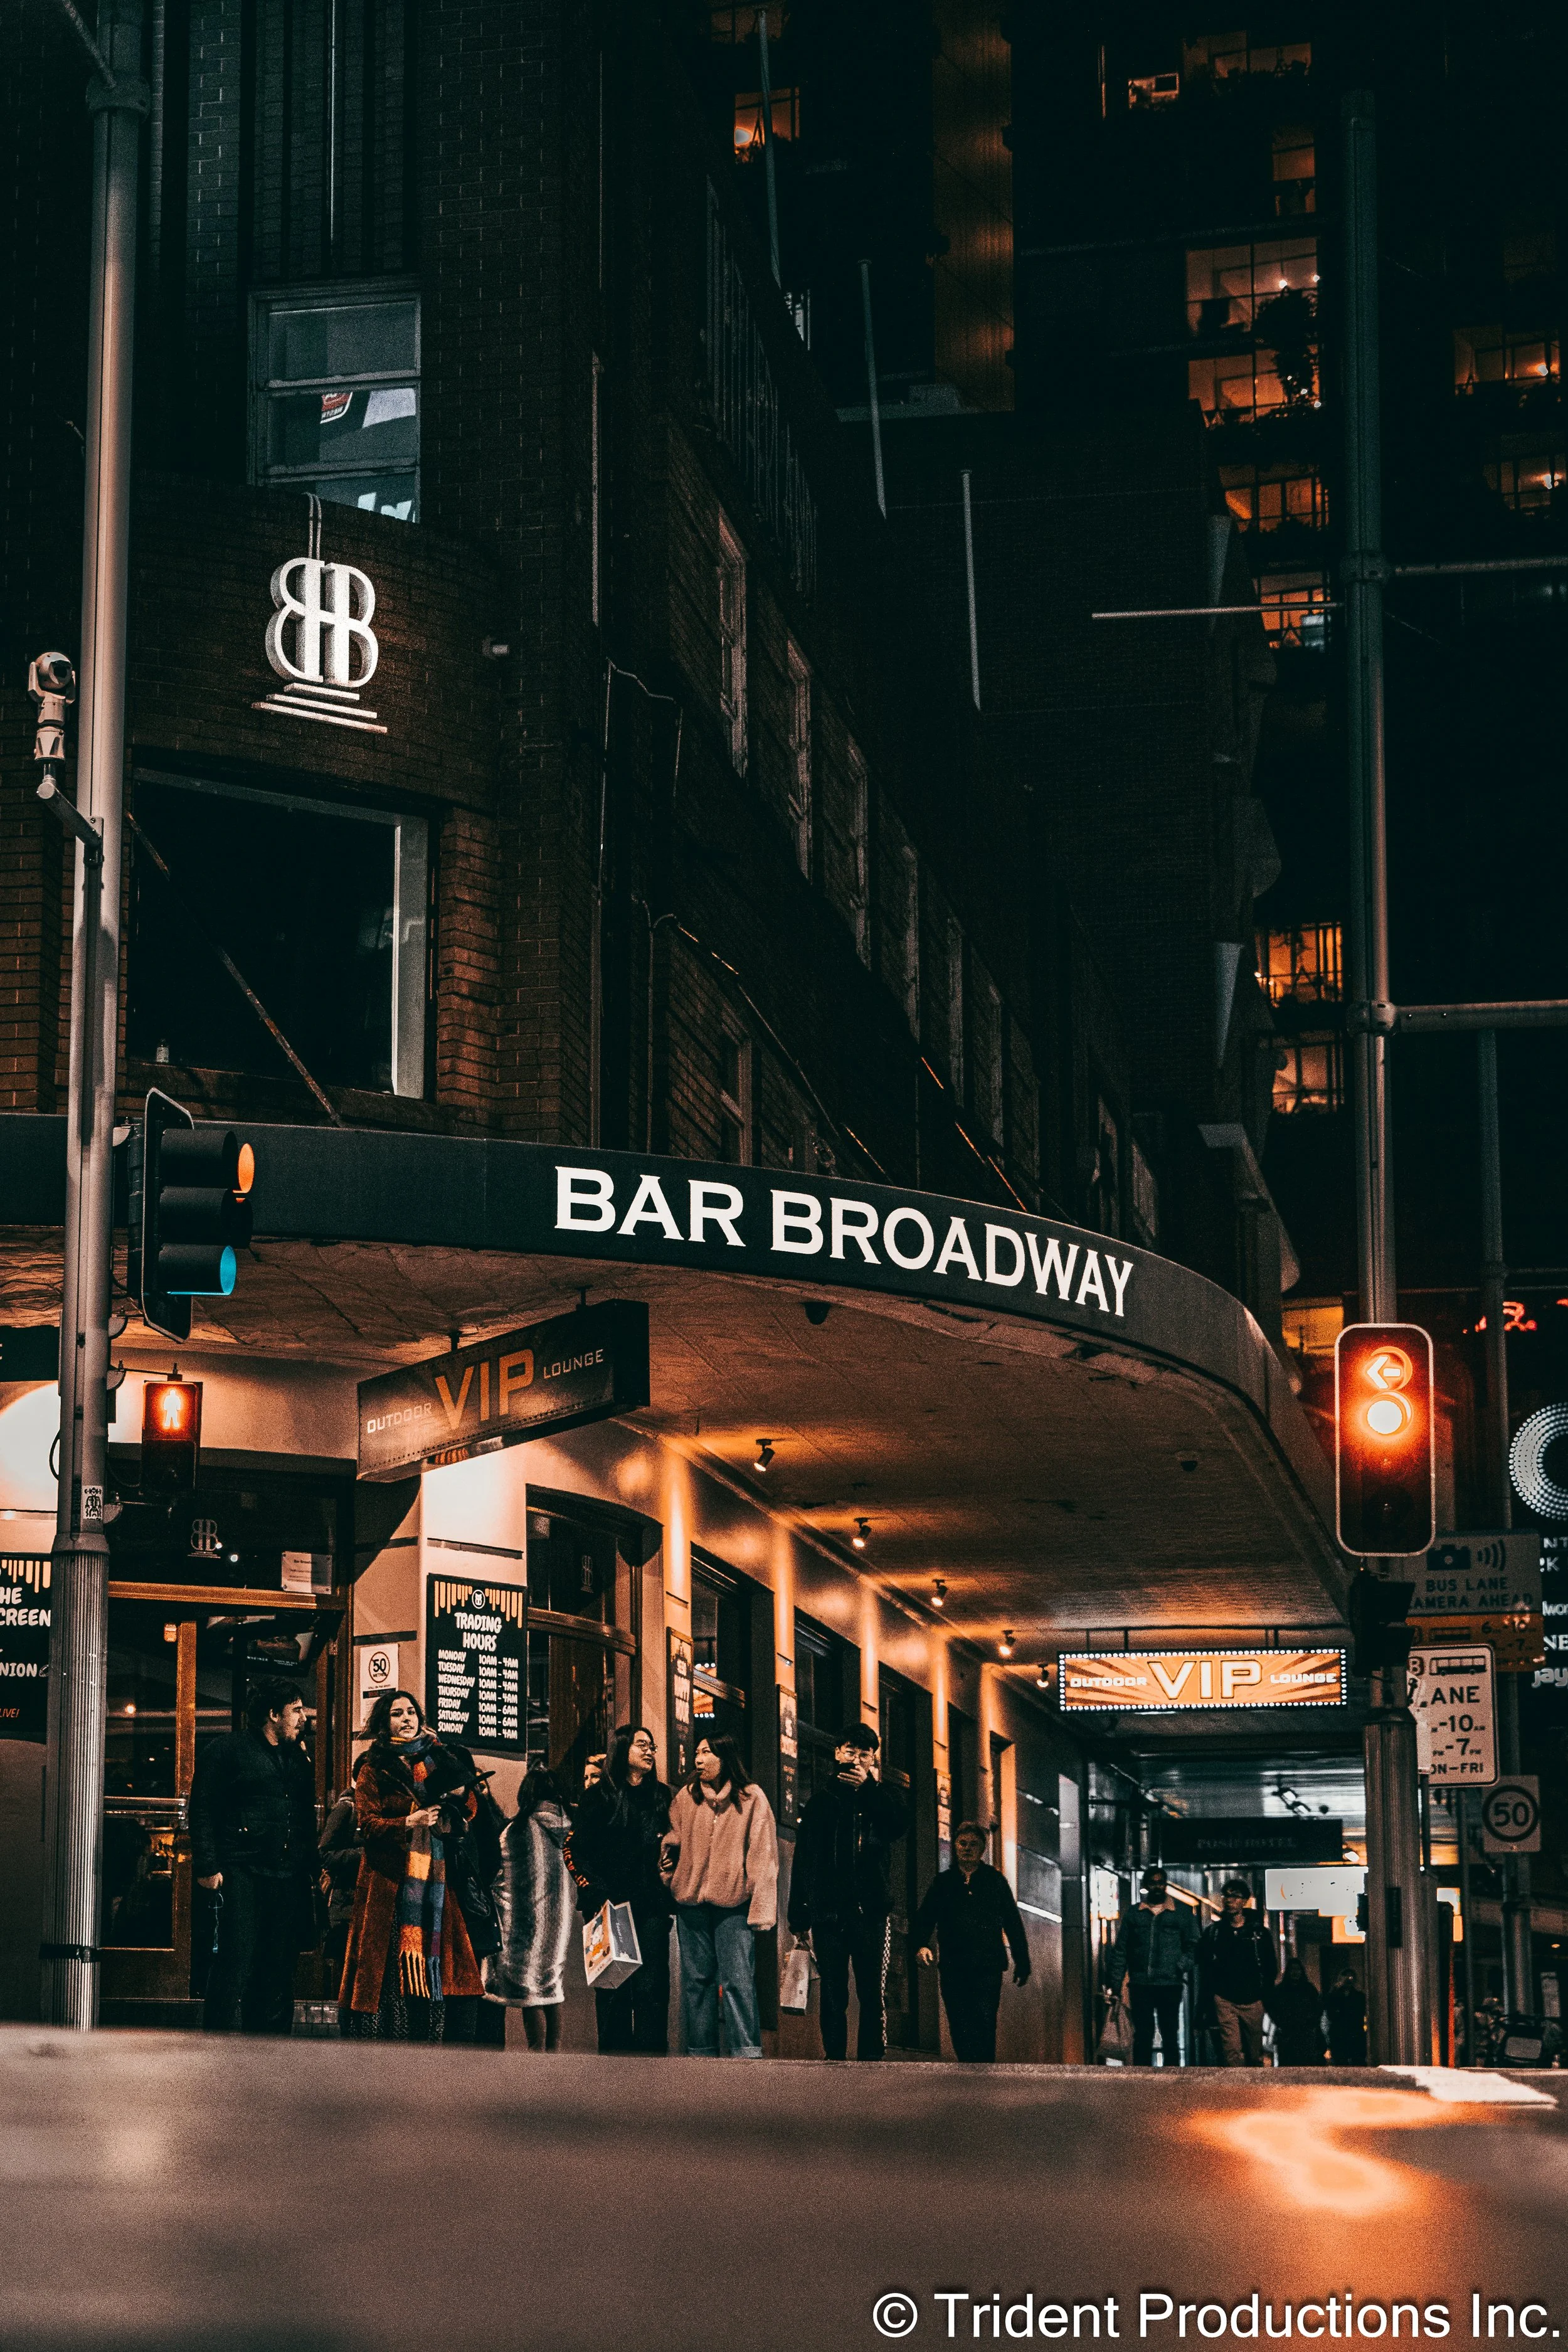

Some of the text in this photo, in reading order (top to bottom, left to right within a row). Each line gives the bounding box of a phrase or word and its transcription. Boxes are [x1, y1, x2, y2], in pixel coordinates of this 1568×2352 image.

[554, 1165, 1134, 1317] BAR BROADWAY
[367, 1348, 604, 1434] OUTDOOR VIP LOUNGE
[1426, 1577, 1507, 1592] BUS LANE
[1414, 1593, 1532, 1609] AMERA AHEAD
[454, 1613, 502, 1633] TRADING
[463, 1632, 497, 1651] HOURS
[373, 1658, 386, 1673] 50
[438, 1650, 467, 1662] MONDAY
[479, 1654, 497, 1666] 10AM
[502, 1657, 519, 1668] 4AM
[438, 1661, 465, 1674] TUESDAY
[479, 1666, 497, 1678] 10AM
[502, 1669, 519, 1680] 4AM
[1070, 1659, 1337, 1700] OUTDOOR VIP LOUNGE
[438, 1673, 475, 1687] WEDNESDAY
[479, 1678, 497, 1690] 10AM
[502, 1681, 519, 1692] 4AM
[437, 1685, 469, 1698] THURSDAY
[479, 1690, 497, 1702] 10AM
[502, 1693, 519, 1704] 4AM
[438, 1697, 461, 1709] FRIDAY
[479, 1702, 497, 1714] 10AM
[502, 1705, 519, 1715] 6AM
[438, 1710, 469, 1722] SATURDAY
[479, 1714, 497, 1725] 10AM
[502, 1717, 519, 1727] 6AM
[438, 1722, 464, 1734] SUNDAY
[479, 1726, 497, 1737] 10AM
[502, 1729, 519, 1740] 4AM
[1494, 1801, 1529, 1827] 50
